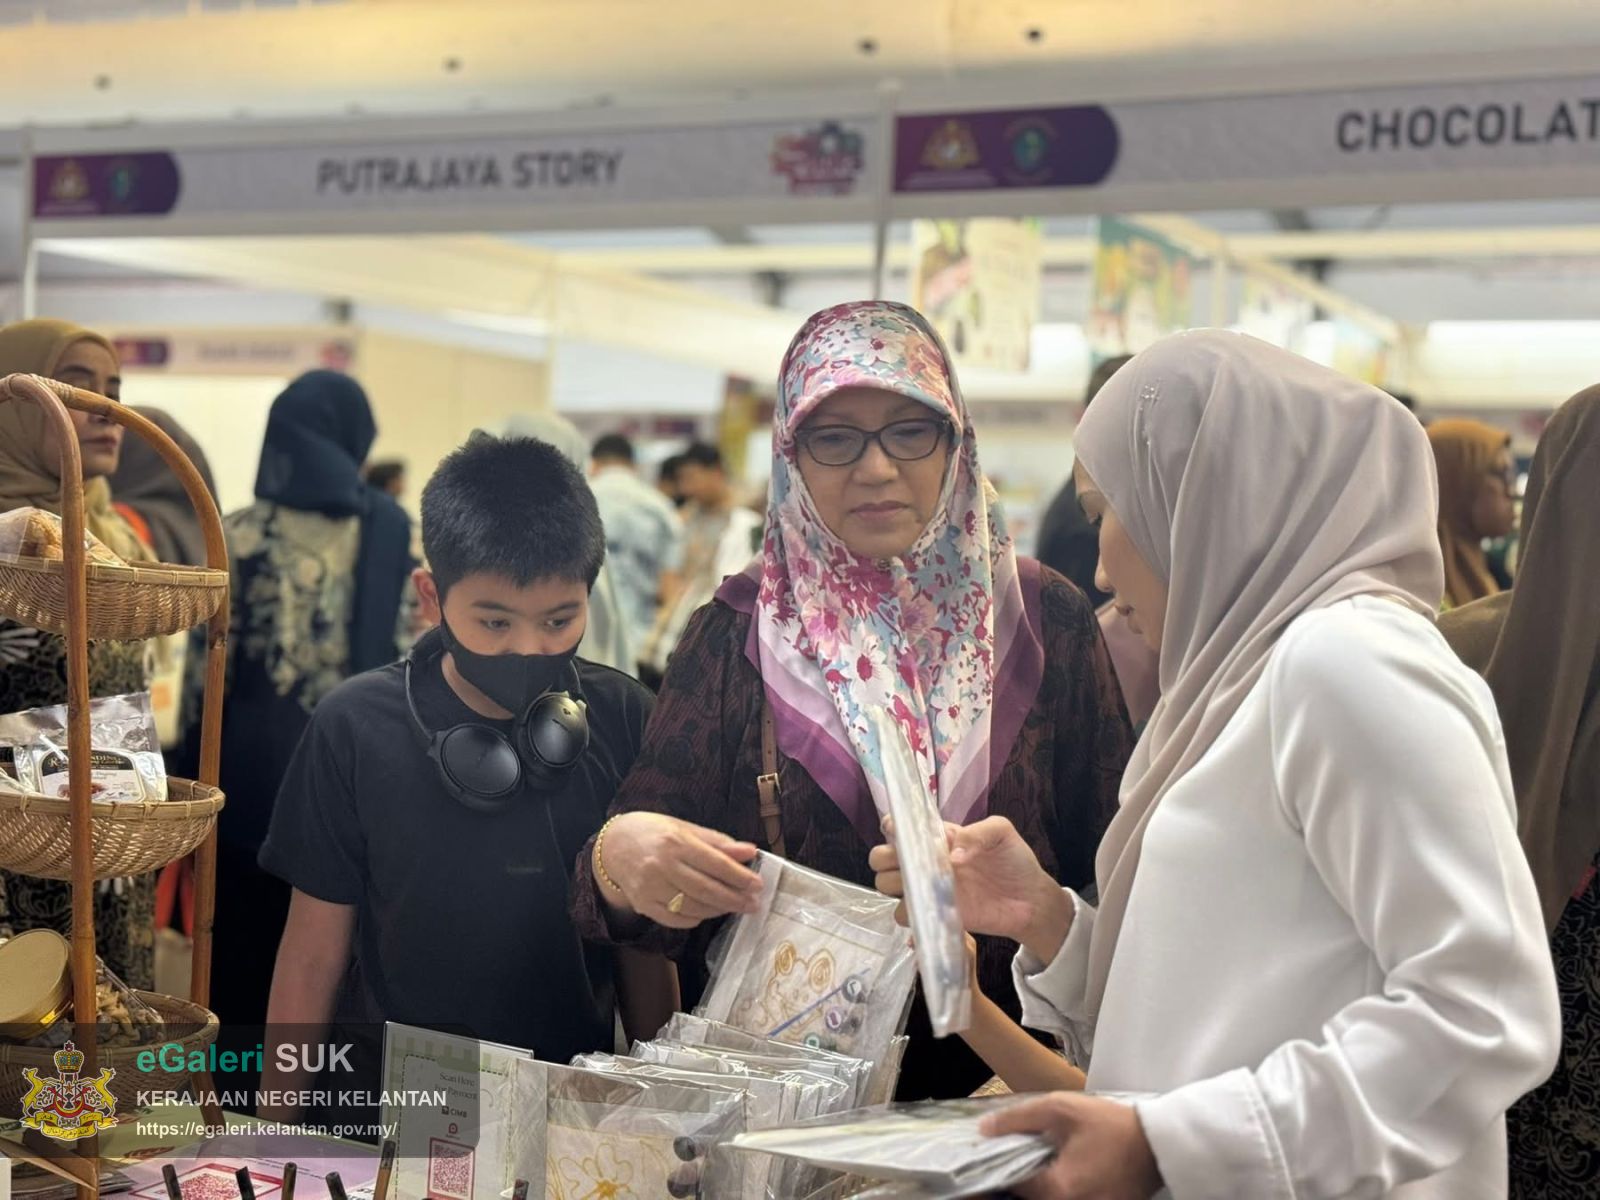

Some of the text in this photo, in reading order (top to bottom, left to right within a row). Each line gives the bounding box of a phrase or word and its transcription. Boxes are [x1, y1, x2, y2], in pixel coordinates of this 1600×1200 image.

[1337, 98, 1600, 152] CHOCOLAT
[316, 150, 623, 195] PUTRAJAYA STORY
[440, 1072, 456, 1083] Scan
